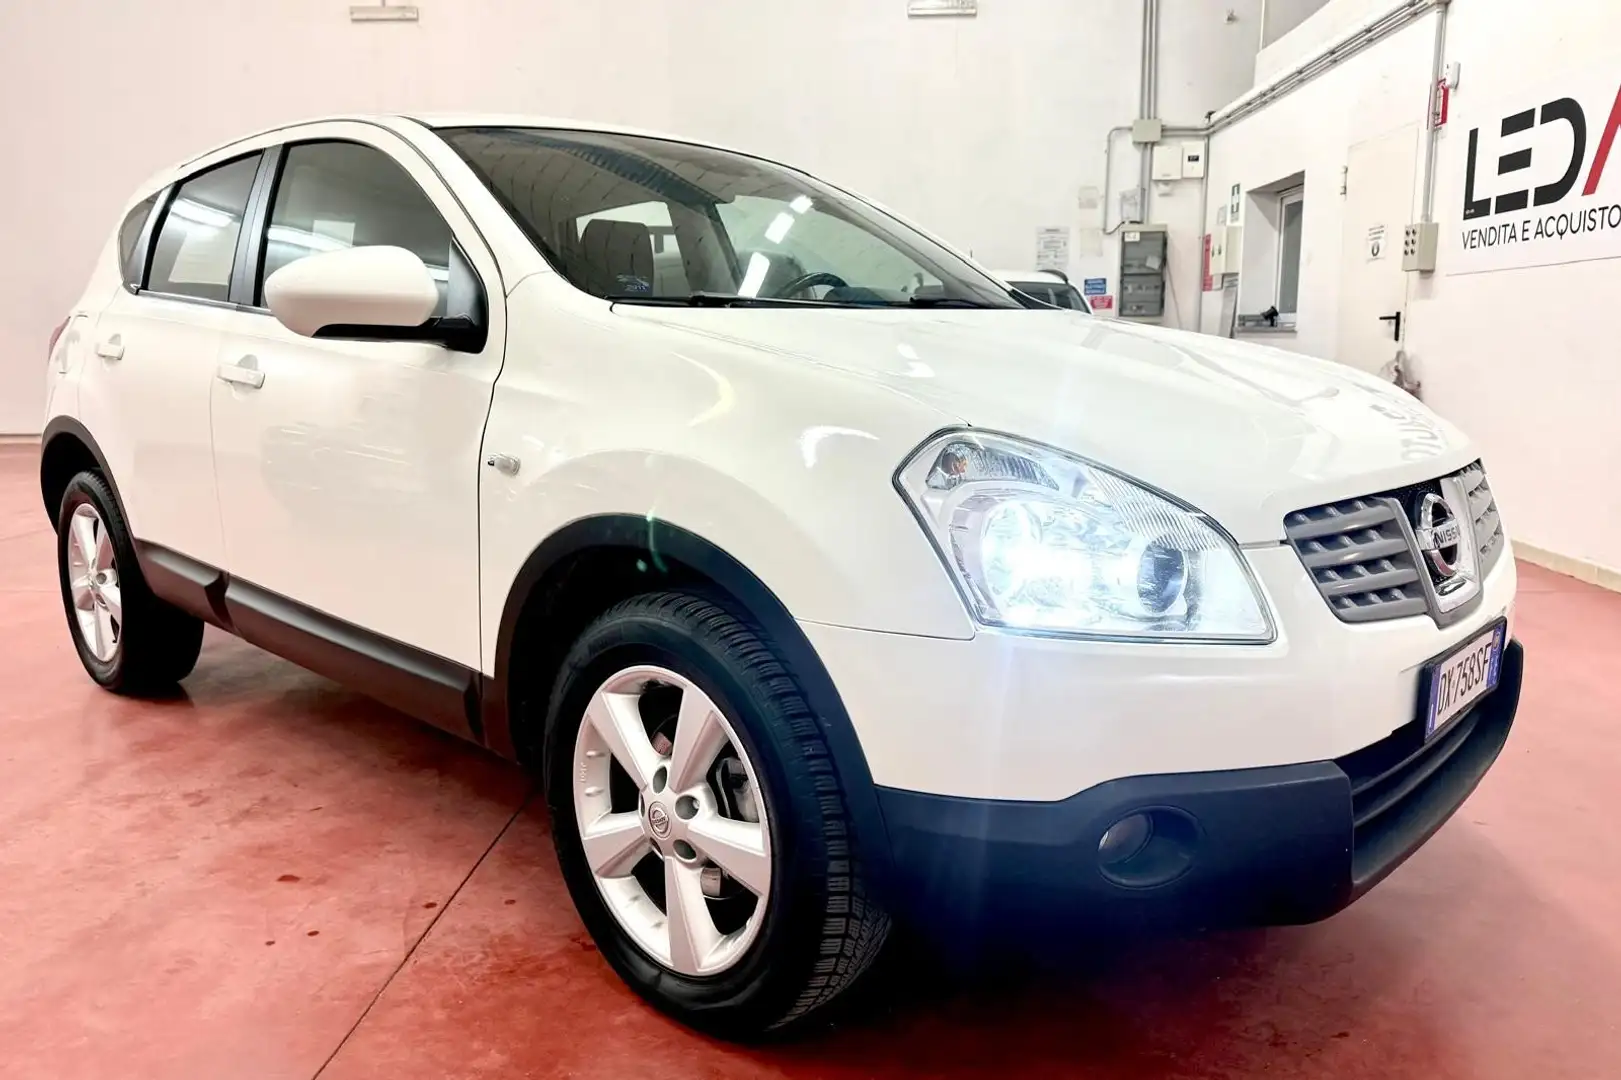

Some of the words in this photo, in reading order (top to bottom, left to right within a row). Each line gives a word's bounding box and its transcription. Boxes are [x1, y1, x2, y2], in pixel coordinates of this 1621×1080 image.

[1462, 223, 1518, 250] VENDITA
[1522, 219, 1531, 242] E
[1534, 204, 1621, 241] ACQUISTO
